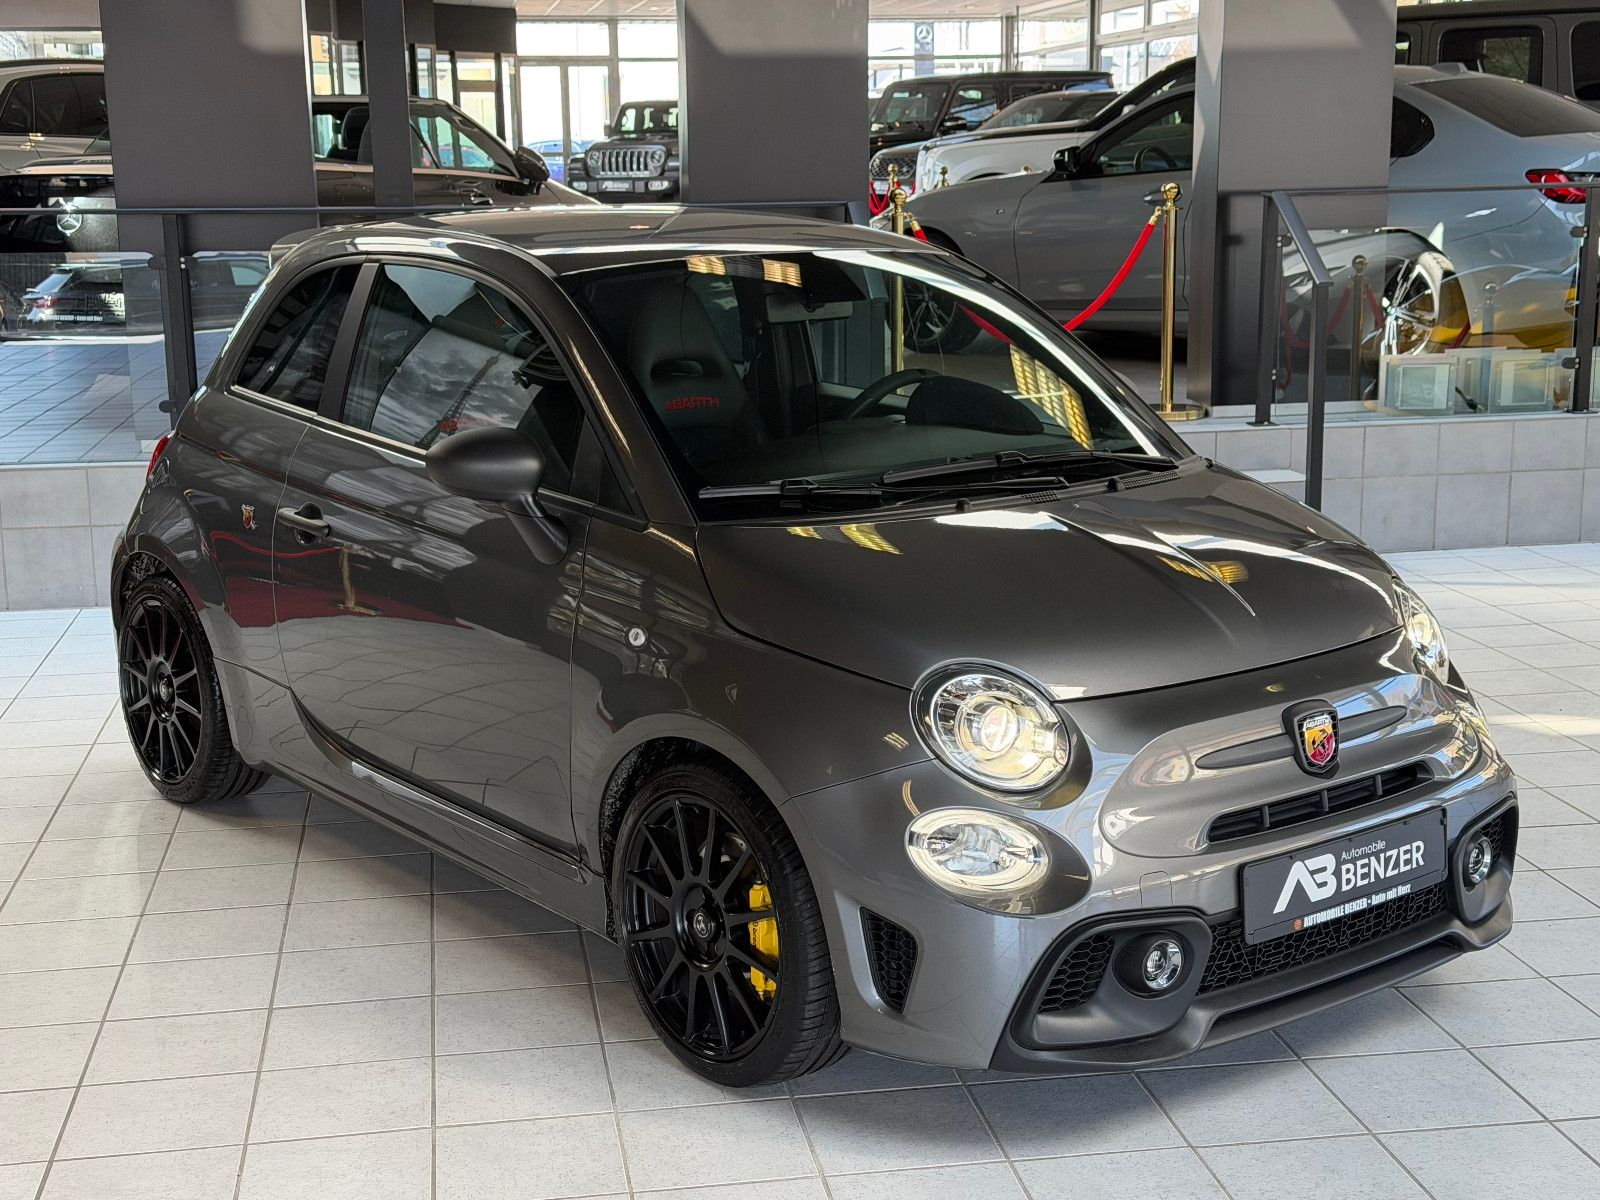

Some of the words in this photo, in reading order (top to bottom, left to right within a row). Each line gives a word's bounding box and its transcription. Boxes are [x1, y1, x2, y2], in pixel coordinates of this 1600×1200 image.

[1341, 840, 1386, 861] Automobile
[1341, 840, 1424, 892] BENZER
[1304, 905, 1344, 927] AUTOMOBILE
[1344, 897, 1367, 914] BENZER
[1372, 893, 1386, 905] Auto
[1386, 888, 1397, 900] mit
[1397, 884, 1411, 896] Herz
